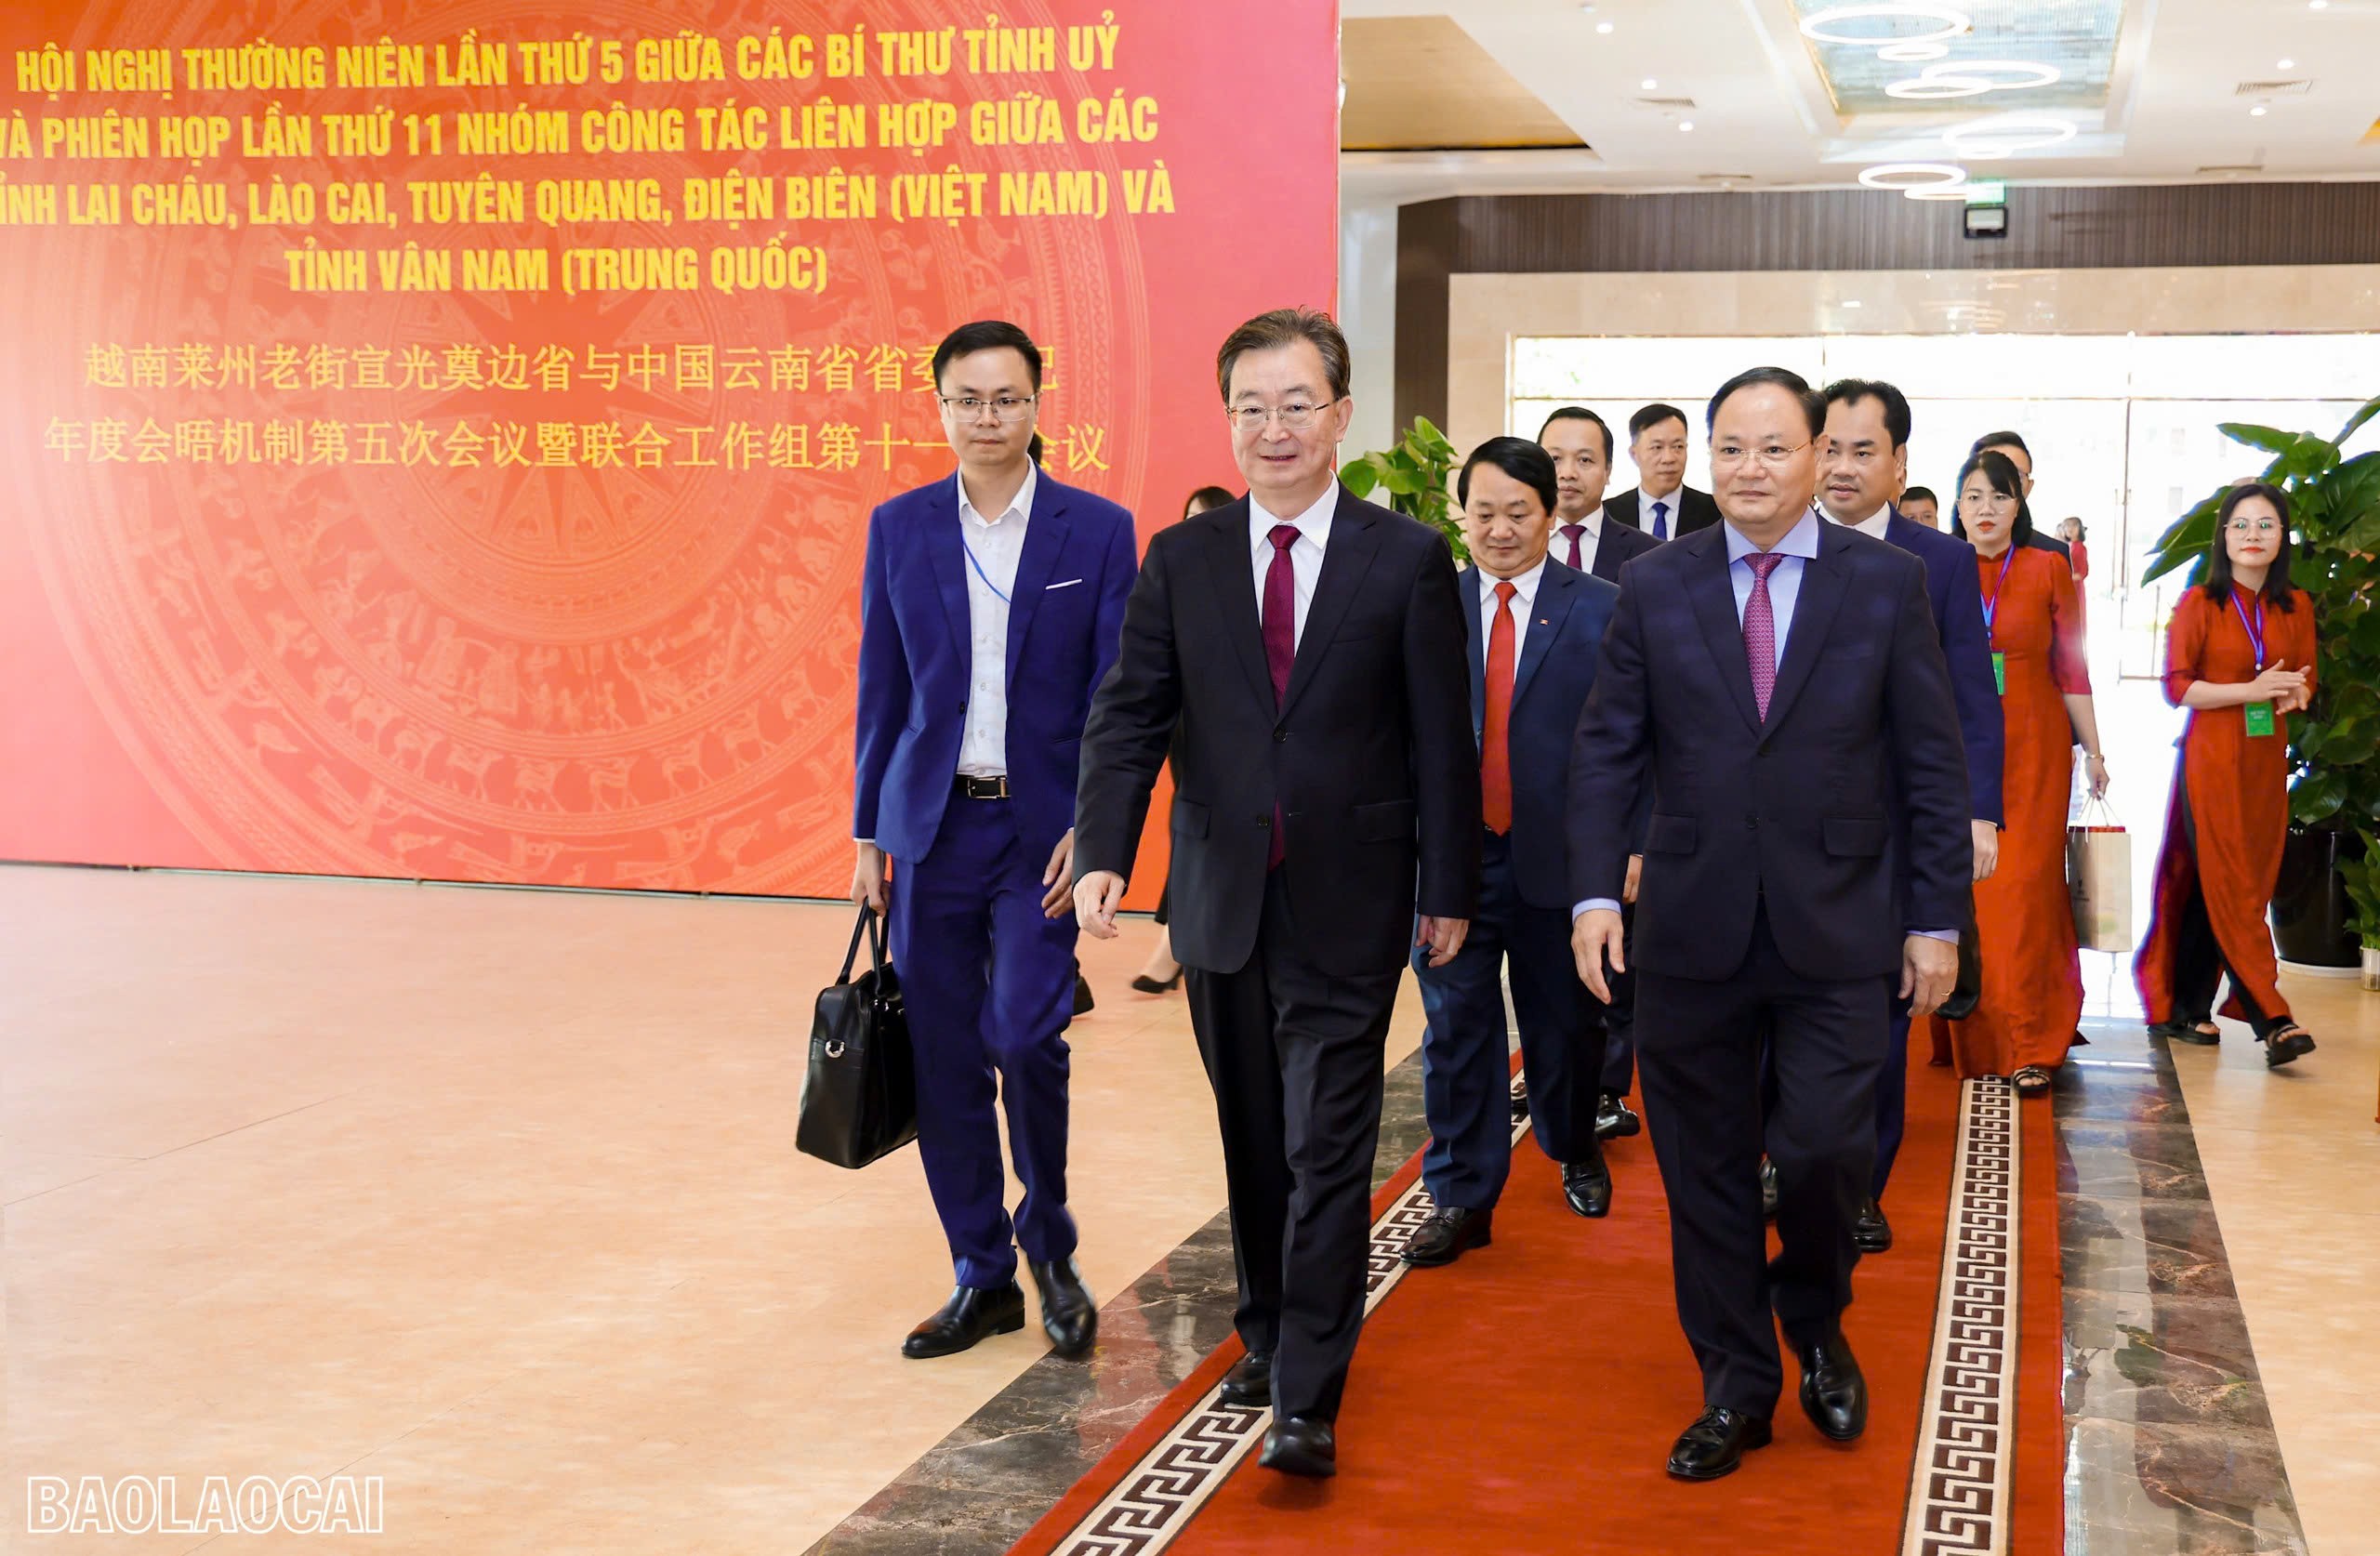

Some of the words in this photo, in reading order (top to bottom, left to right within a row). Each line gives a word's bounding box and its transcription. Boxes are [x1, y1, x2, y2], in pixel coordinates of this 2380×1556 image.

[16, 41, 73, 99] HỘI
[86, 48, 171, 99] NGHỊ
[181, 37, 324, 89] THƯỜNG
[337, 37, 423, 86] NIÊN
[435, 29, 507, 86] LẦN
[518, 30, 593, 83] THỨ
[602, 40, 623, 82] 5
[635, 30, 724, 81] GIỮA
[737, 26, 814, 79] CÁC
[827, 23, 865, 76] BÍ
[878, 26, 956, 74] THƯ
[963, 14, 1054, 73] TỈNH
[1069, 9, 1120, 71] UỶ
[43, 110, 148, 157] PHIÊN
[160, 116, 230, 165] HỌP
[242, 100, 311, 157] LẦN
[320, 104, 396, 156] THỨ
[404, 113, 442, 155] 11
[458, 104, 567, 152] NHÓM
[581, 100, 685, 153] CÔNG
[695, 99, 769, 152] TÁC
[781, 97, 865, 148] LIÊN
[879, 99, 956, 155] HỢP
[971, 92, 1064, 144] GIỮA
[1077, 87, 1159, 143] CÁC
[0, 170, 57, 224] ỈNH
[67, 183, 119, 224] LAI
[132, 174, 238, 230] CHÂU,
[247, 175, 315, 224] LÀO
[327, 181, 397, 229] CAI,
[408, 172, 522, 223] TUYÊN
[536, 178, 671, 226] QUANG,
[683, 168, 774, 229] ĐIỆN
[787, 167, 876, 218] BIÊN
[892, 165, 987, 227] (VIỆT
[999, 171, 1107, 218] NAM)
[1123, 160, 1175, 213] VÀ
[284, 236, 366, 290] TỈNH
[378, 242, 450, 291] VÂN
[464, 249, 549, 290] NAM
[561, 248, 698, 294] (TRUNG
[711, 231, 827, 295] QUỐC)
